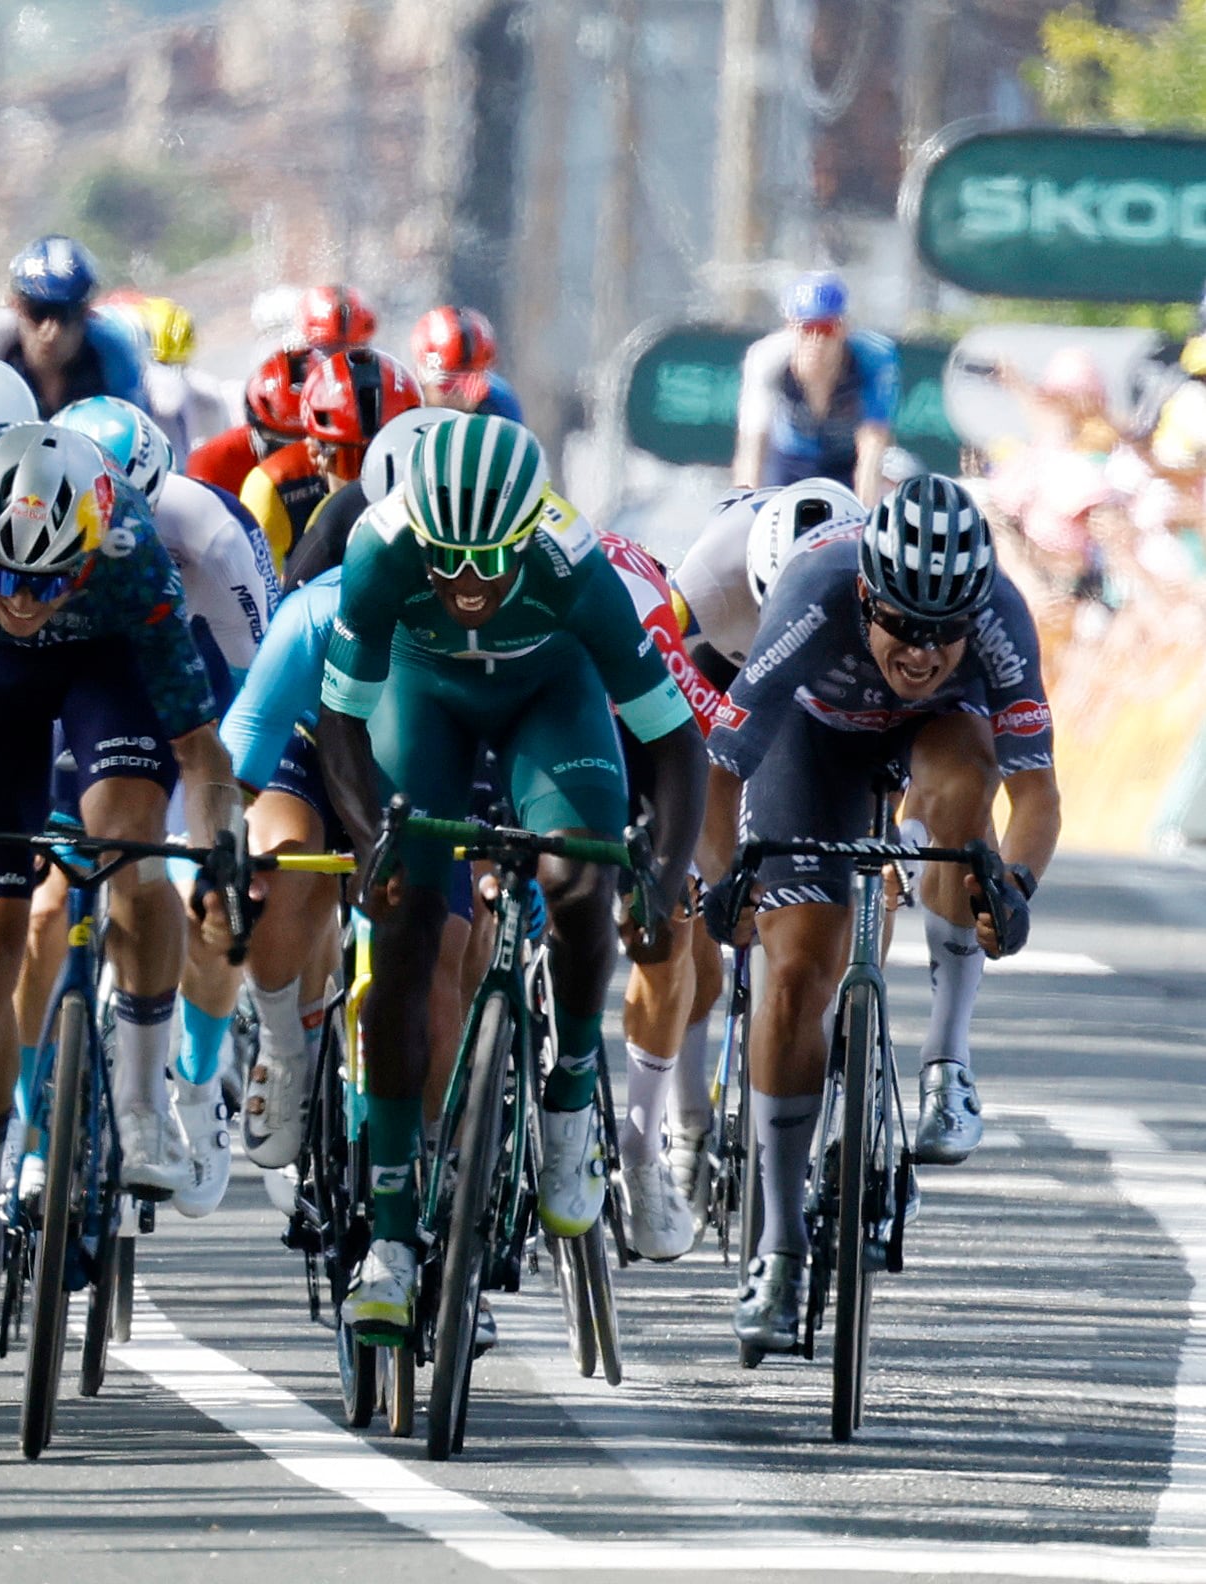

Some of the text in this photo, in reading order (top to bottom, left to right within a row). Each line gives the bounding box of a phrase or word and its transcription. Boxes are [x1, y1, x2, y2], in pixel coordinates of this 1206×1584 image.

[959, 177, 1206, 243] SKO
[745, 604, 828, 685] deceuninck
[975, 607, 1028, 688] Alpecin
[997, 708, 1051, 729] Alpecin
